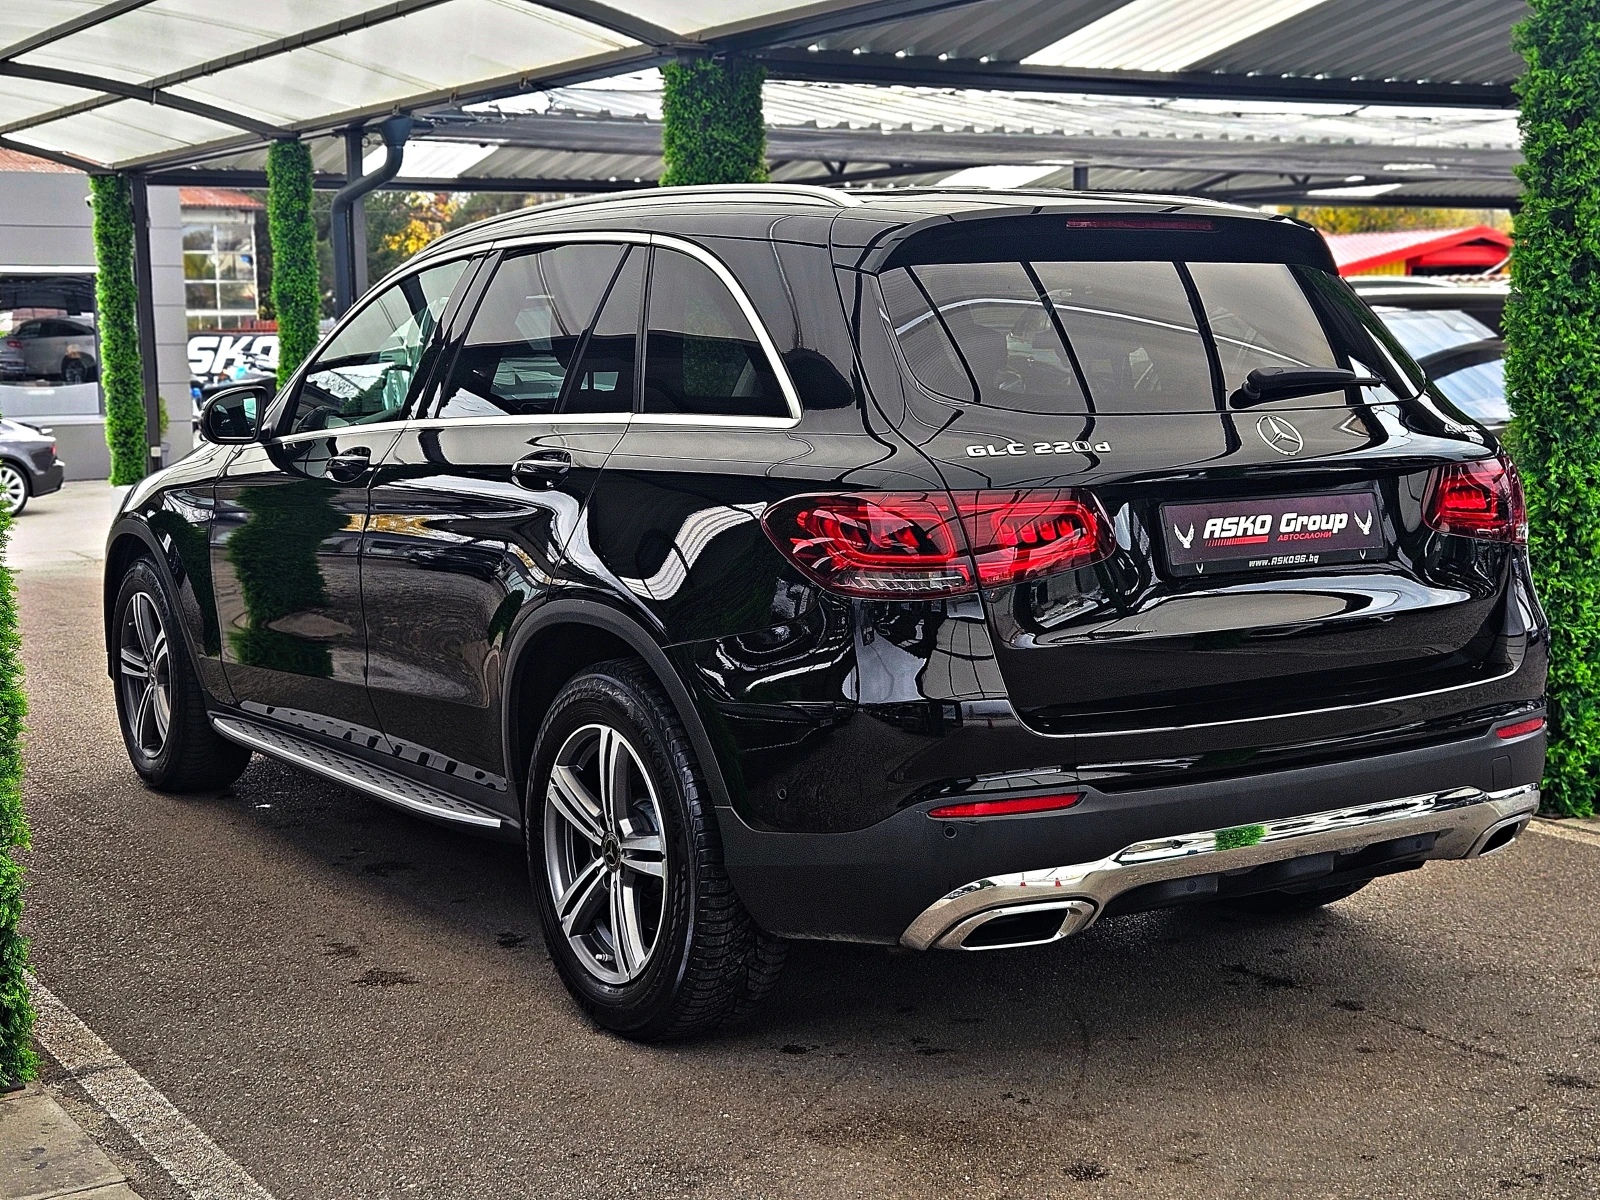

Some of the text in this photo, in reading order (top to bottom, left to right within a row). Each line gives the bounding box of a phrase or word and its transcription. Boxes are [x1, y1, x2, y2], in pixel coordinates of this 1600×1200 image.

[966, 443, 1027, 457] GLC
[1203, 513, 1349, 539] ASKO Group
[1277, 531, 1332, 542] АВТОСАЛОНИ
[1248, 554, 1320, 568] www.ASKO96.bg
